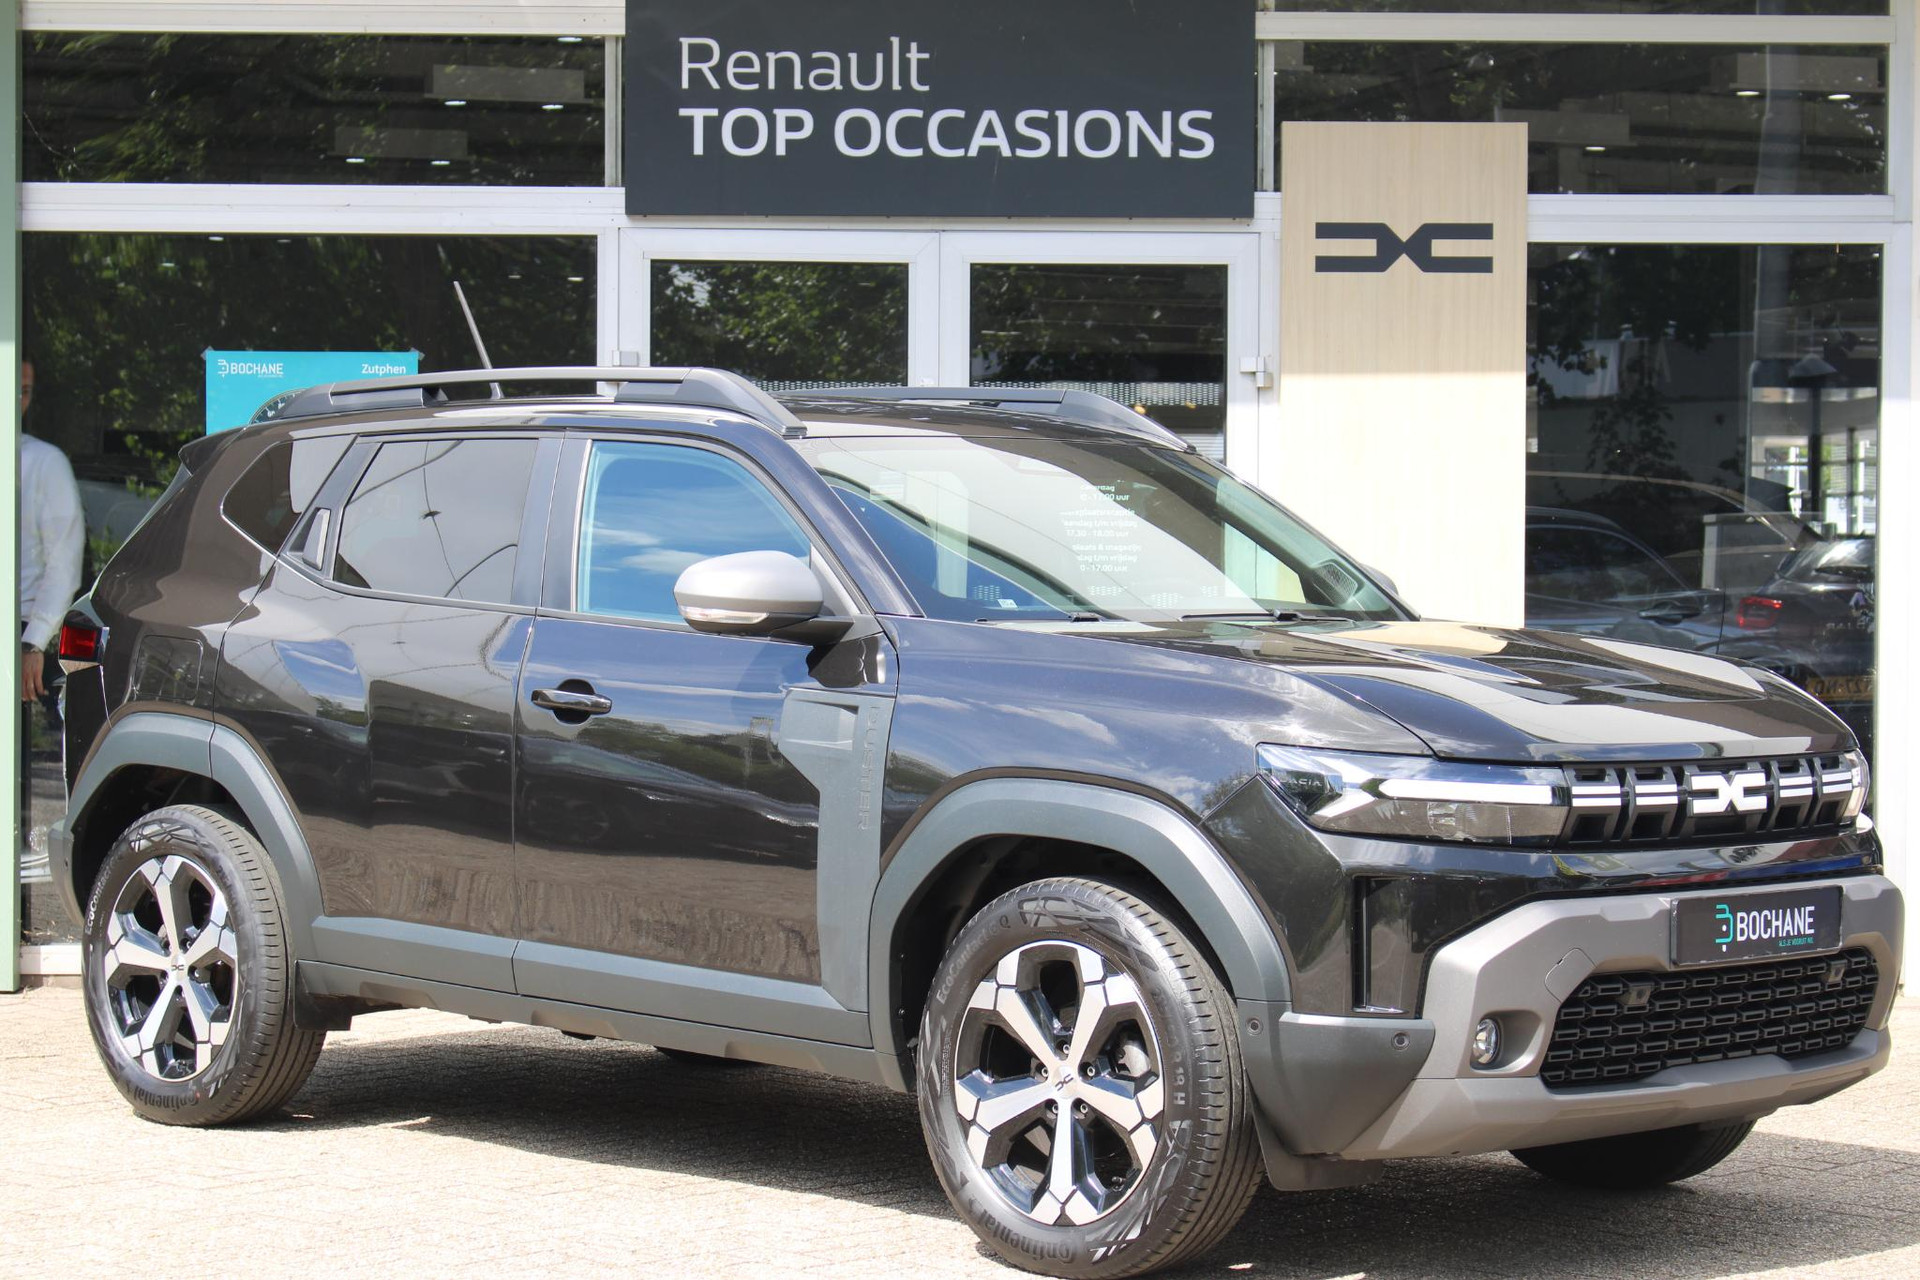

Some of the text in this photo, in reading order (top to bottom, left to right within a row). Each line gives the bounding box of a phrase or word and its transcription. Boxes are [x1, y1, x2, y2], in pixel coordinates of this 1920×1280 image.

[679, 36, 930, 91] Renault
[679, 107, 1215, 159] TOP OCCASIONS
[231, 362, 284, 375] BOCHANE
[362, 364, 406, 377] Zutphen
[859, 706, 881, 830] DUSTER
[1736, 906, 1815, 941] BOCHANE
[979, 1209, 1076, 1264] Continental
